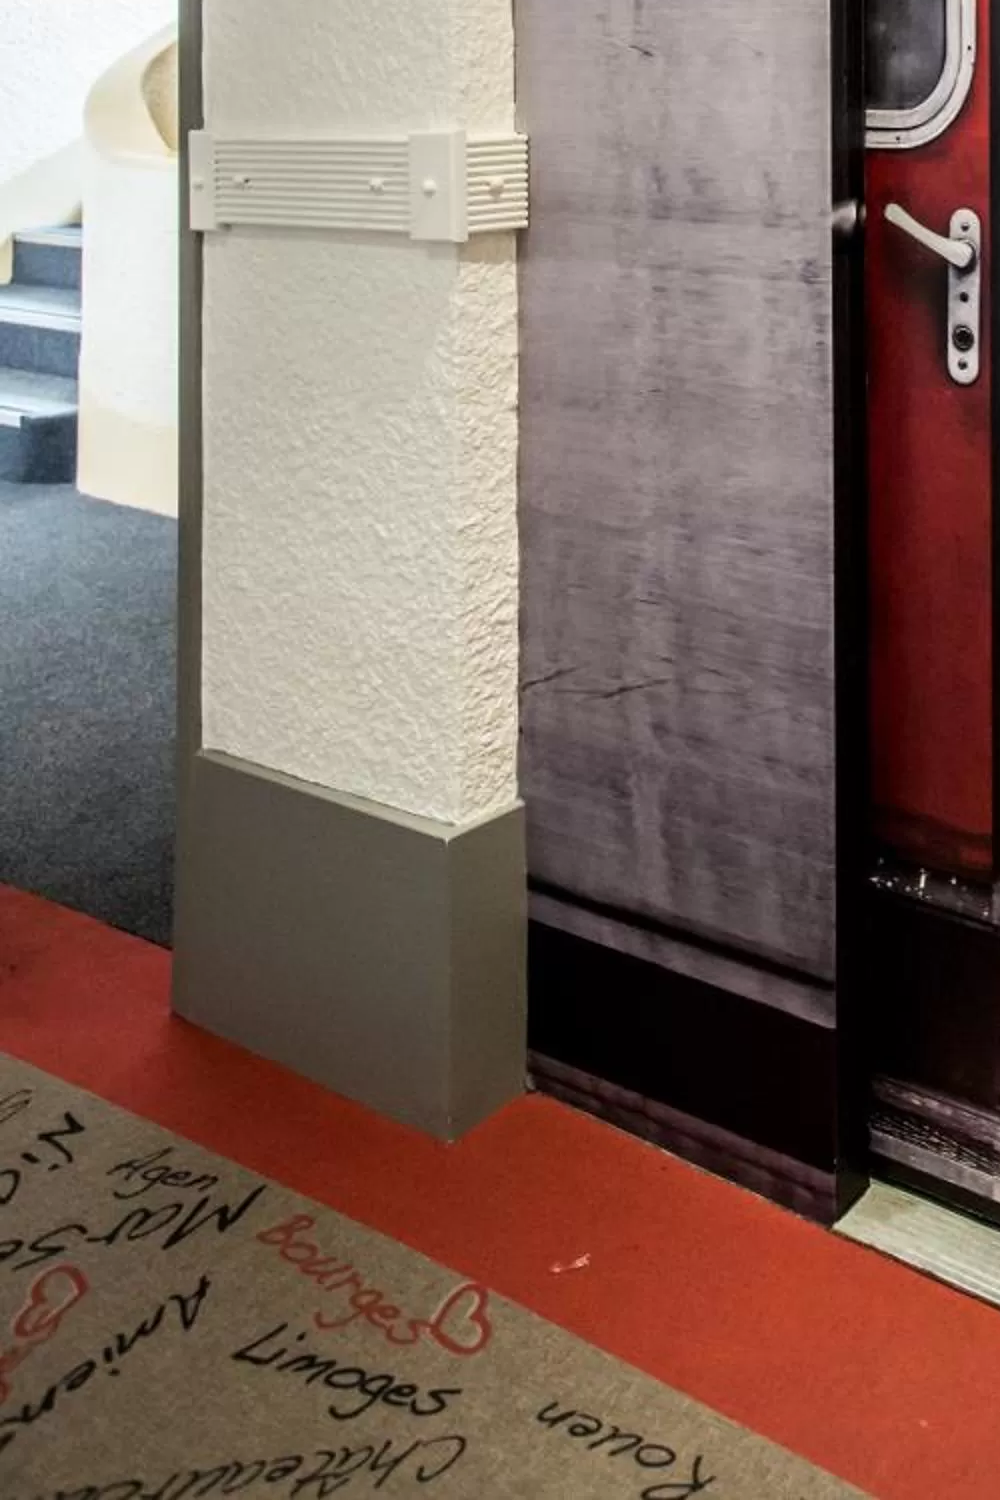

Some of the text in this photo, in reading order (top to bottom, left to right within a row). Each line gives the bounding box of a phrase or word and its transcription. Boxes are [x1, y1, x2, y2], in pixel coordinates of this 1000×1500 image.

[106, 1146, 219, 1200] Agen
[257, 1213, 432, 1347] Bourges
[0, 1275, 210, 1453] Amien
[231, 1322, 463, 1422] Limoges
[536, 1401, 717, 1500] Rouen
